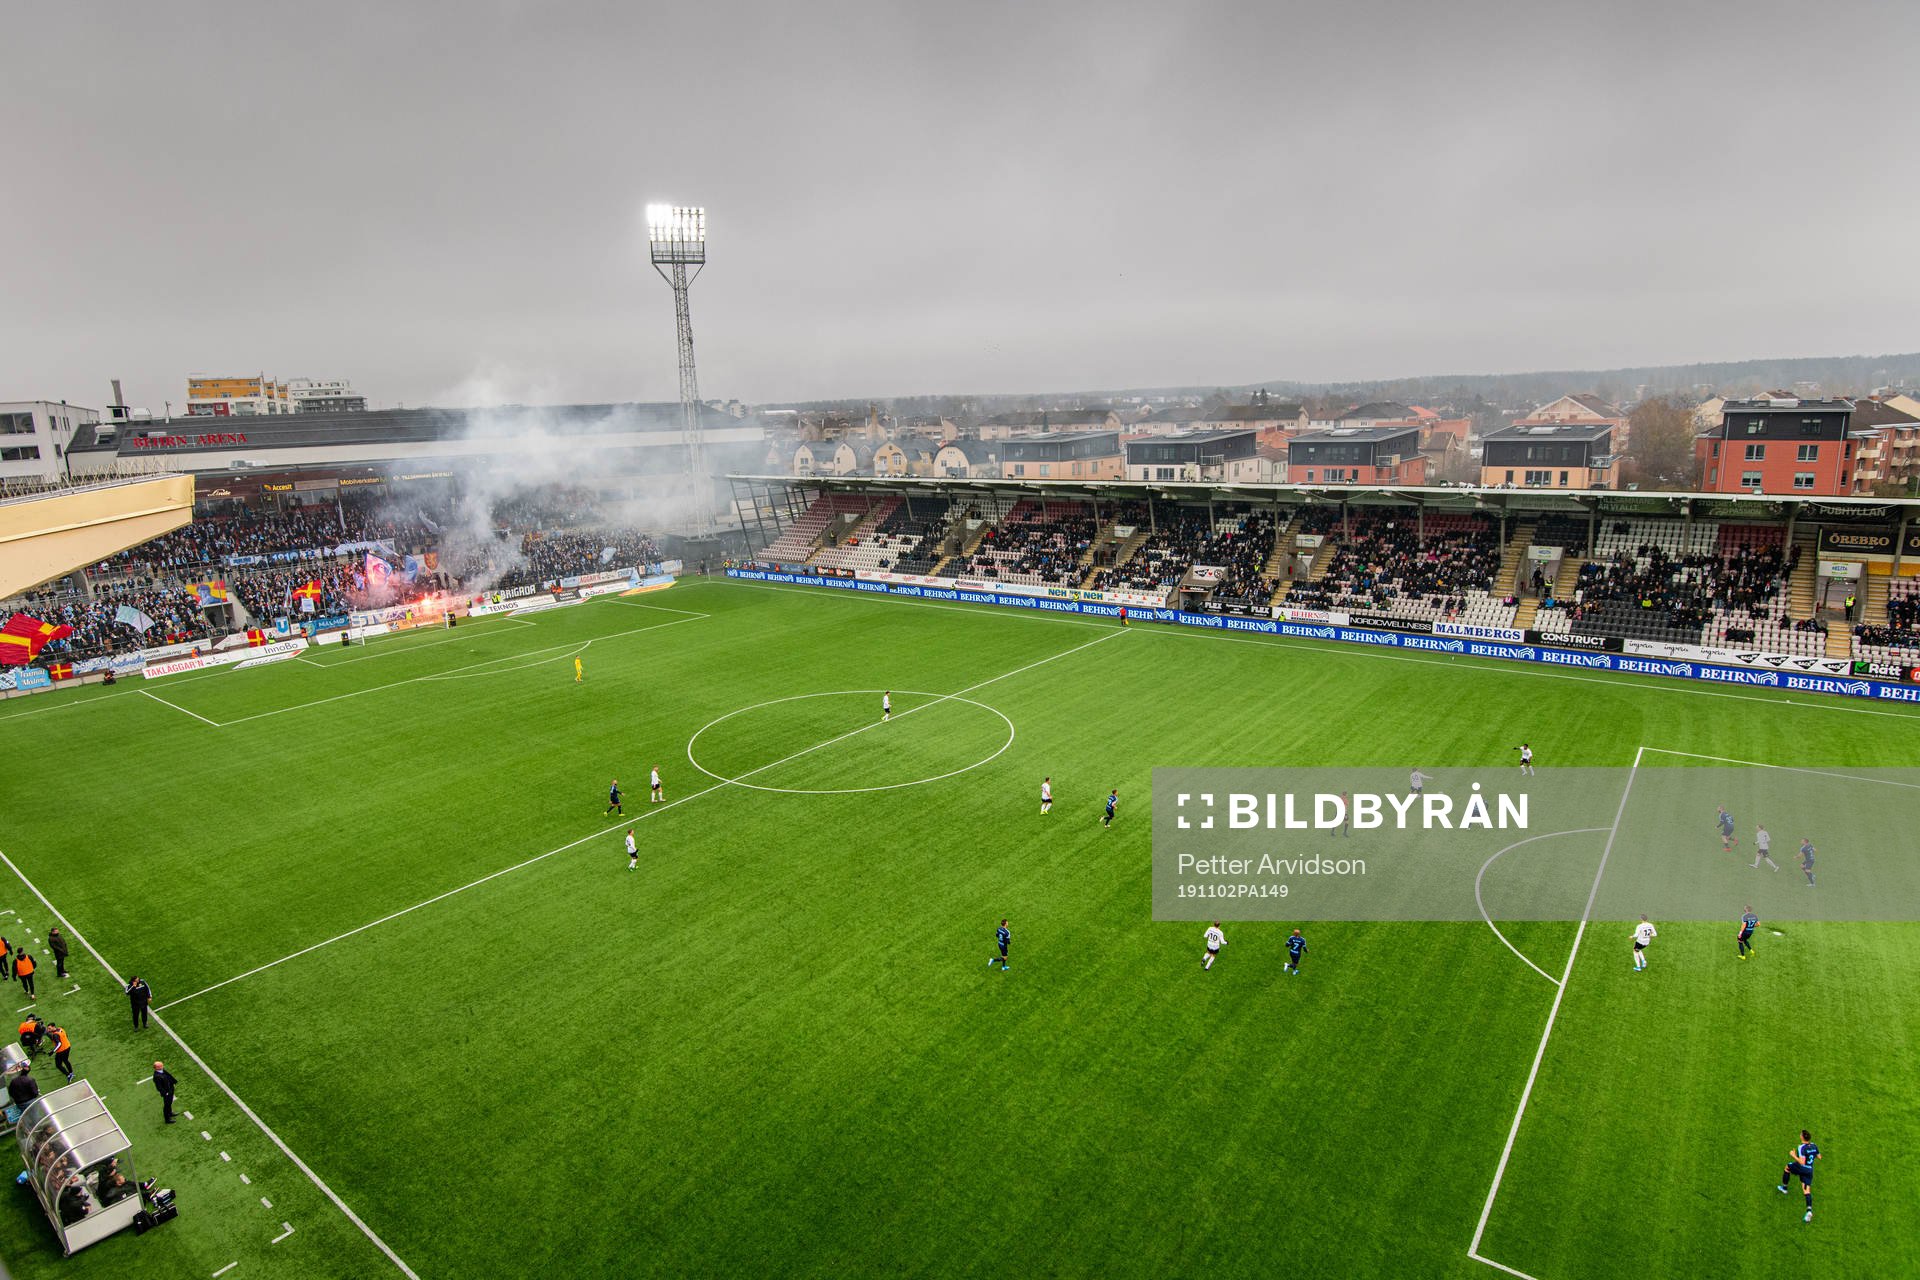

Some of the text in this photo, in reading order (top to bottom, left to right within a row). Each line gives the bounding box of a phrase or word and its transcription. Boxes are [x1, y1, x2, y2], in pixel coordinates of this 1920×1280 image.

[133, 432, 247, 448] BEHRN ARENA
[1819, 505, 1886, 517] PUBHYLLAN
[1829, 532, 1890, 546] ÖREBRO
[501, 584, 536, 599] BRIGADA
[923, 589, 949, 599] BEHRN
[960, 593, 987, 603] BEHRN
[489, 602, 519, 612] TEKNOS
[999, 596, 1026, 607] BEHRN
[1040, 600, 1069, 611] BEHRN
[1083, 604, 1115, 616] BEHRN
[1227, 619, 1265, 632] BEHRN
[1350, 616, 1432, 631] NORDICWELLNESS
[1282, 624, 1322, 638] BEHRN
[1341, 630, 1383, 644] BEHRN
[1435, 623, 1521, 640] MALMBERGS
[1404, 637, 1448, 650] BEHRN
[1541, 632, 1606, 646] CONSTRUCT
[263, 642, 298, 654] InnoBo
[1470, 644, 1518, 659] BEHRN
[1542, 651, 1593, 667] BEHRN
[1618, 659, 1674, 675] BEHRN
[1868, 662, 1901, 676] Rätt
[1700, 668, 1759, 684] BEHRN
[1787, 677, 1850, 694] BEHRN
